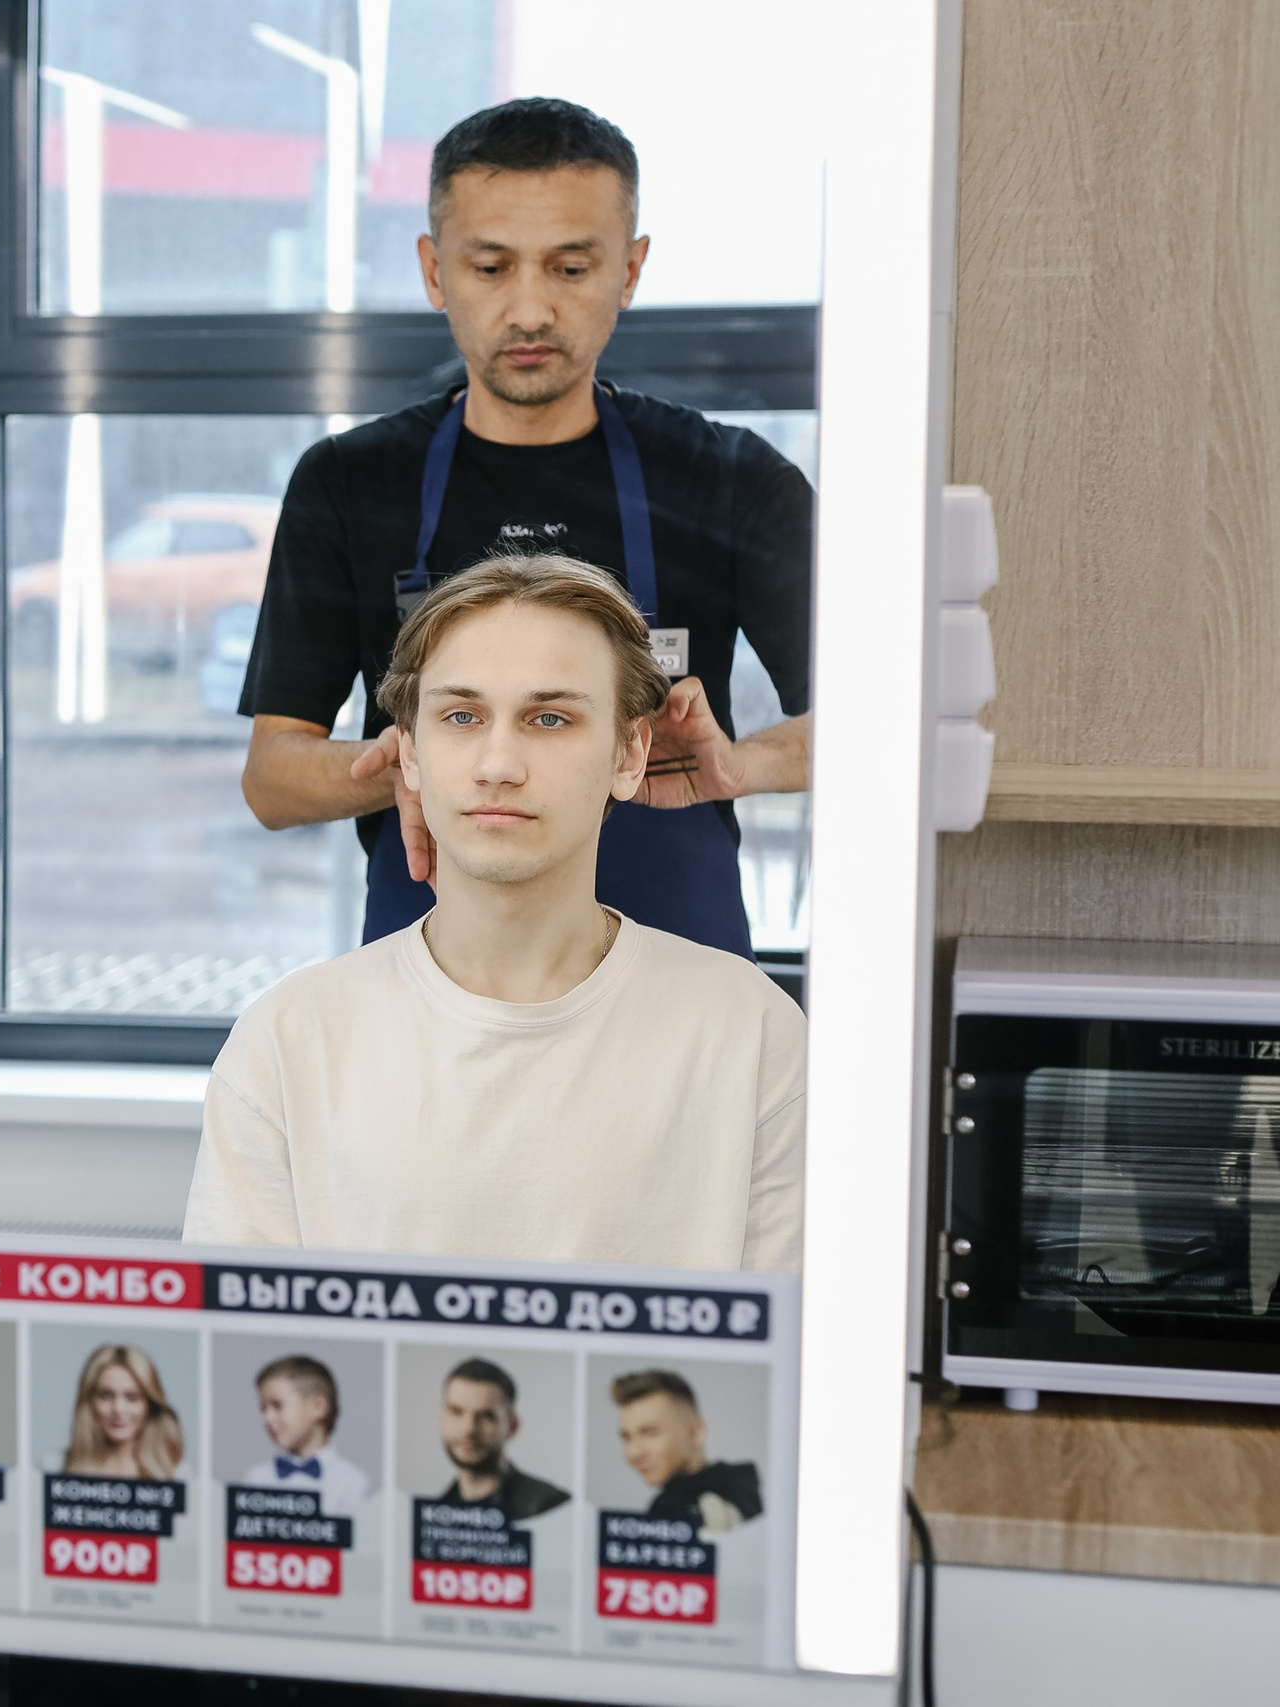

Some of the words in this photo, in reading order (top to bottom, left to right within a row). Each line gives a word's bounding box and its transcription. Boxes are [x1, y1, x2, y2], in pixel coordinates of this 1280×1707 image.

[18, 1263, 187, 1305] КОМБО
[218, 1272, 422, 1320] ВЫГОДА
[434, 1283, 498, 1321] ОТ
[501, 1286, 559, 1325] 50
[565, 1291, 638, 1331] ДО
[643, 1295, 721, 1334] 150
[50, 1478, 132, 1505] КОМБО
[234, 1491, 318, 1517] КОМБО
[51, 1503, 162, 1532] ЖЕНСКОЕ
[234, 1514, 338, 1543] ДЕТСКОЕ
[420, 1503, 506, 1531] КОМБО
[605, 1516, 694, 1544] КОМБО
[605, 1540, 708, 1569] БАРБЕР
